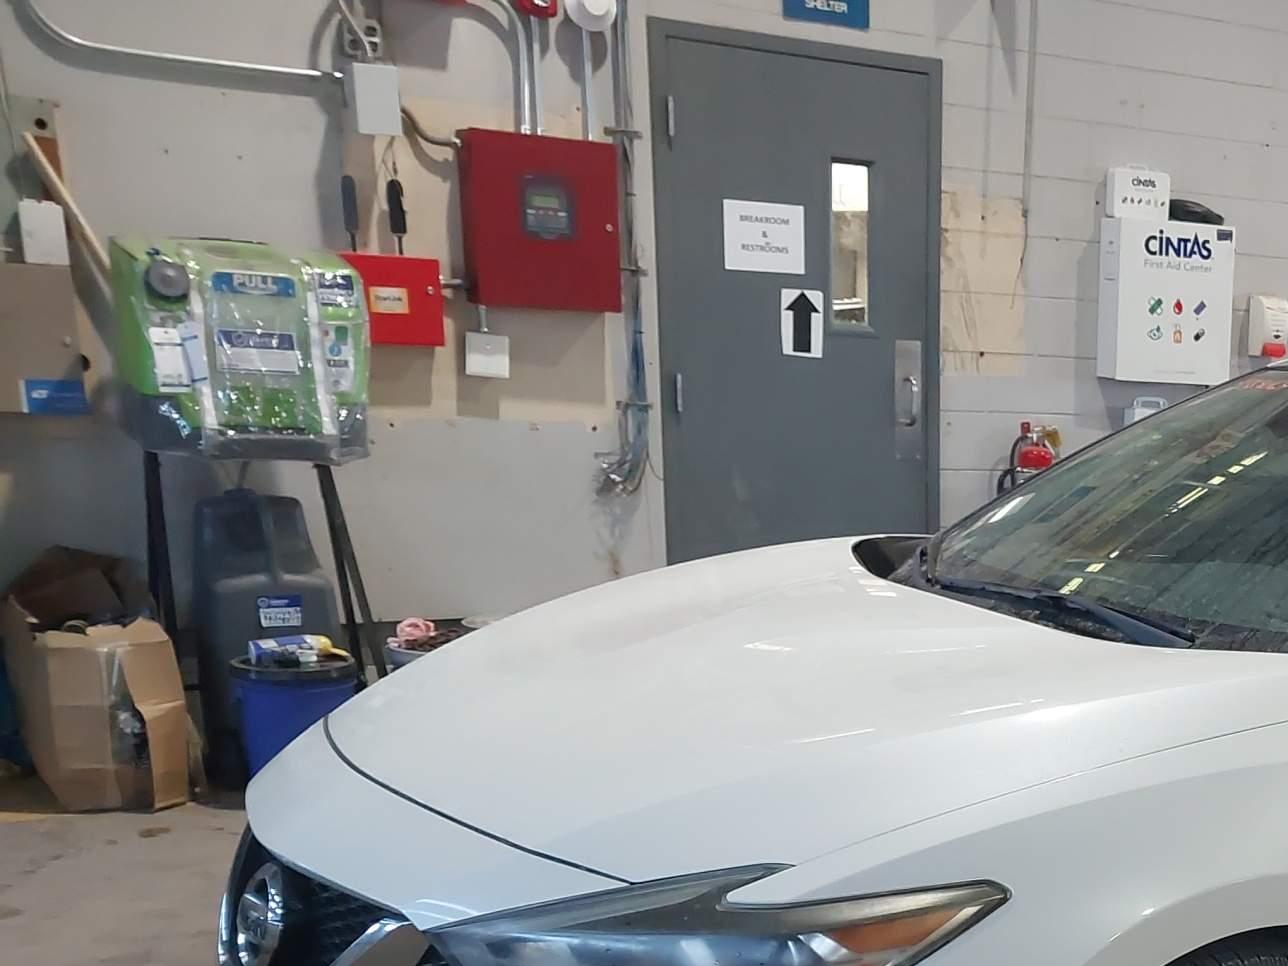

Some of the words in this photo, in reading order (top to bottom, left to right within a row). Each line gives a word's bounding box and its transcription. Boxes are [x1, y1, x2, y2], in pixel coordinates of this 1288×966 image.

[804, 0, 848, 14] SHELTER
[739, 214, 790, 226] BREAKROOM
[761, 230, 769, 239] &
[741, 243, 790, 255] RESTROOMS
[1143, 259, 1164, 270] First
[1166, 261, 1181, 271] Aid
[1183, 262, 1213, 273] Center
[232, 274, 277, 289] PULL
